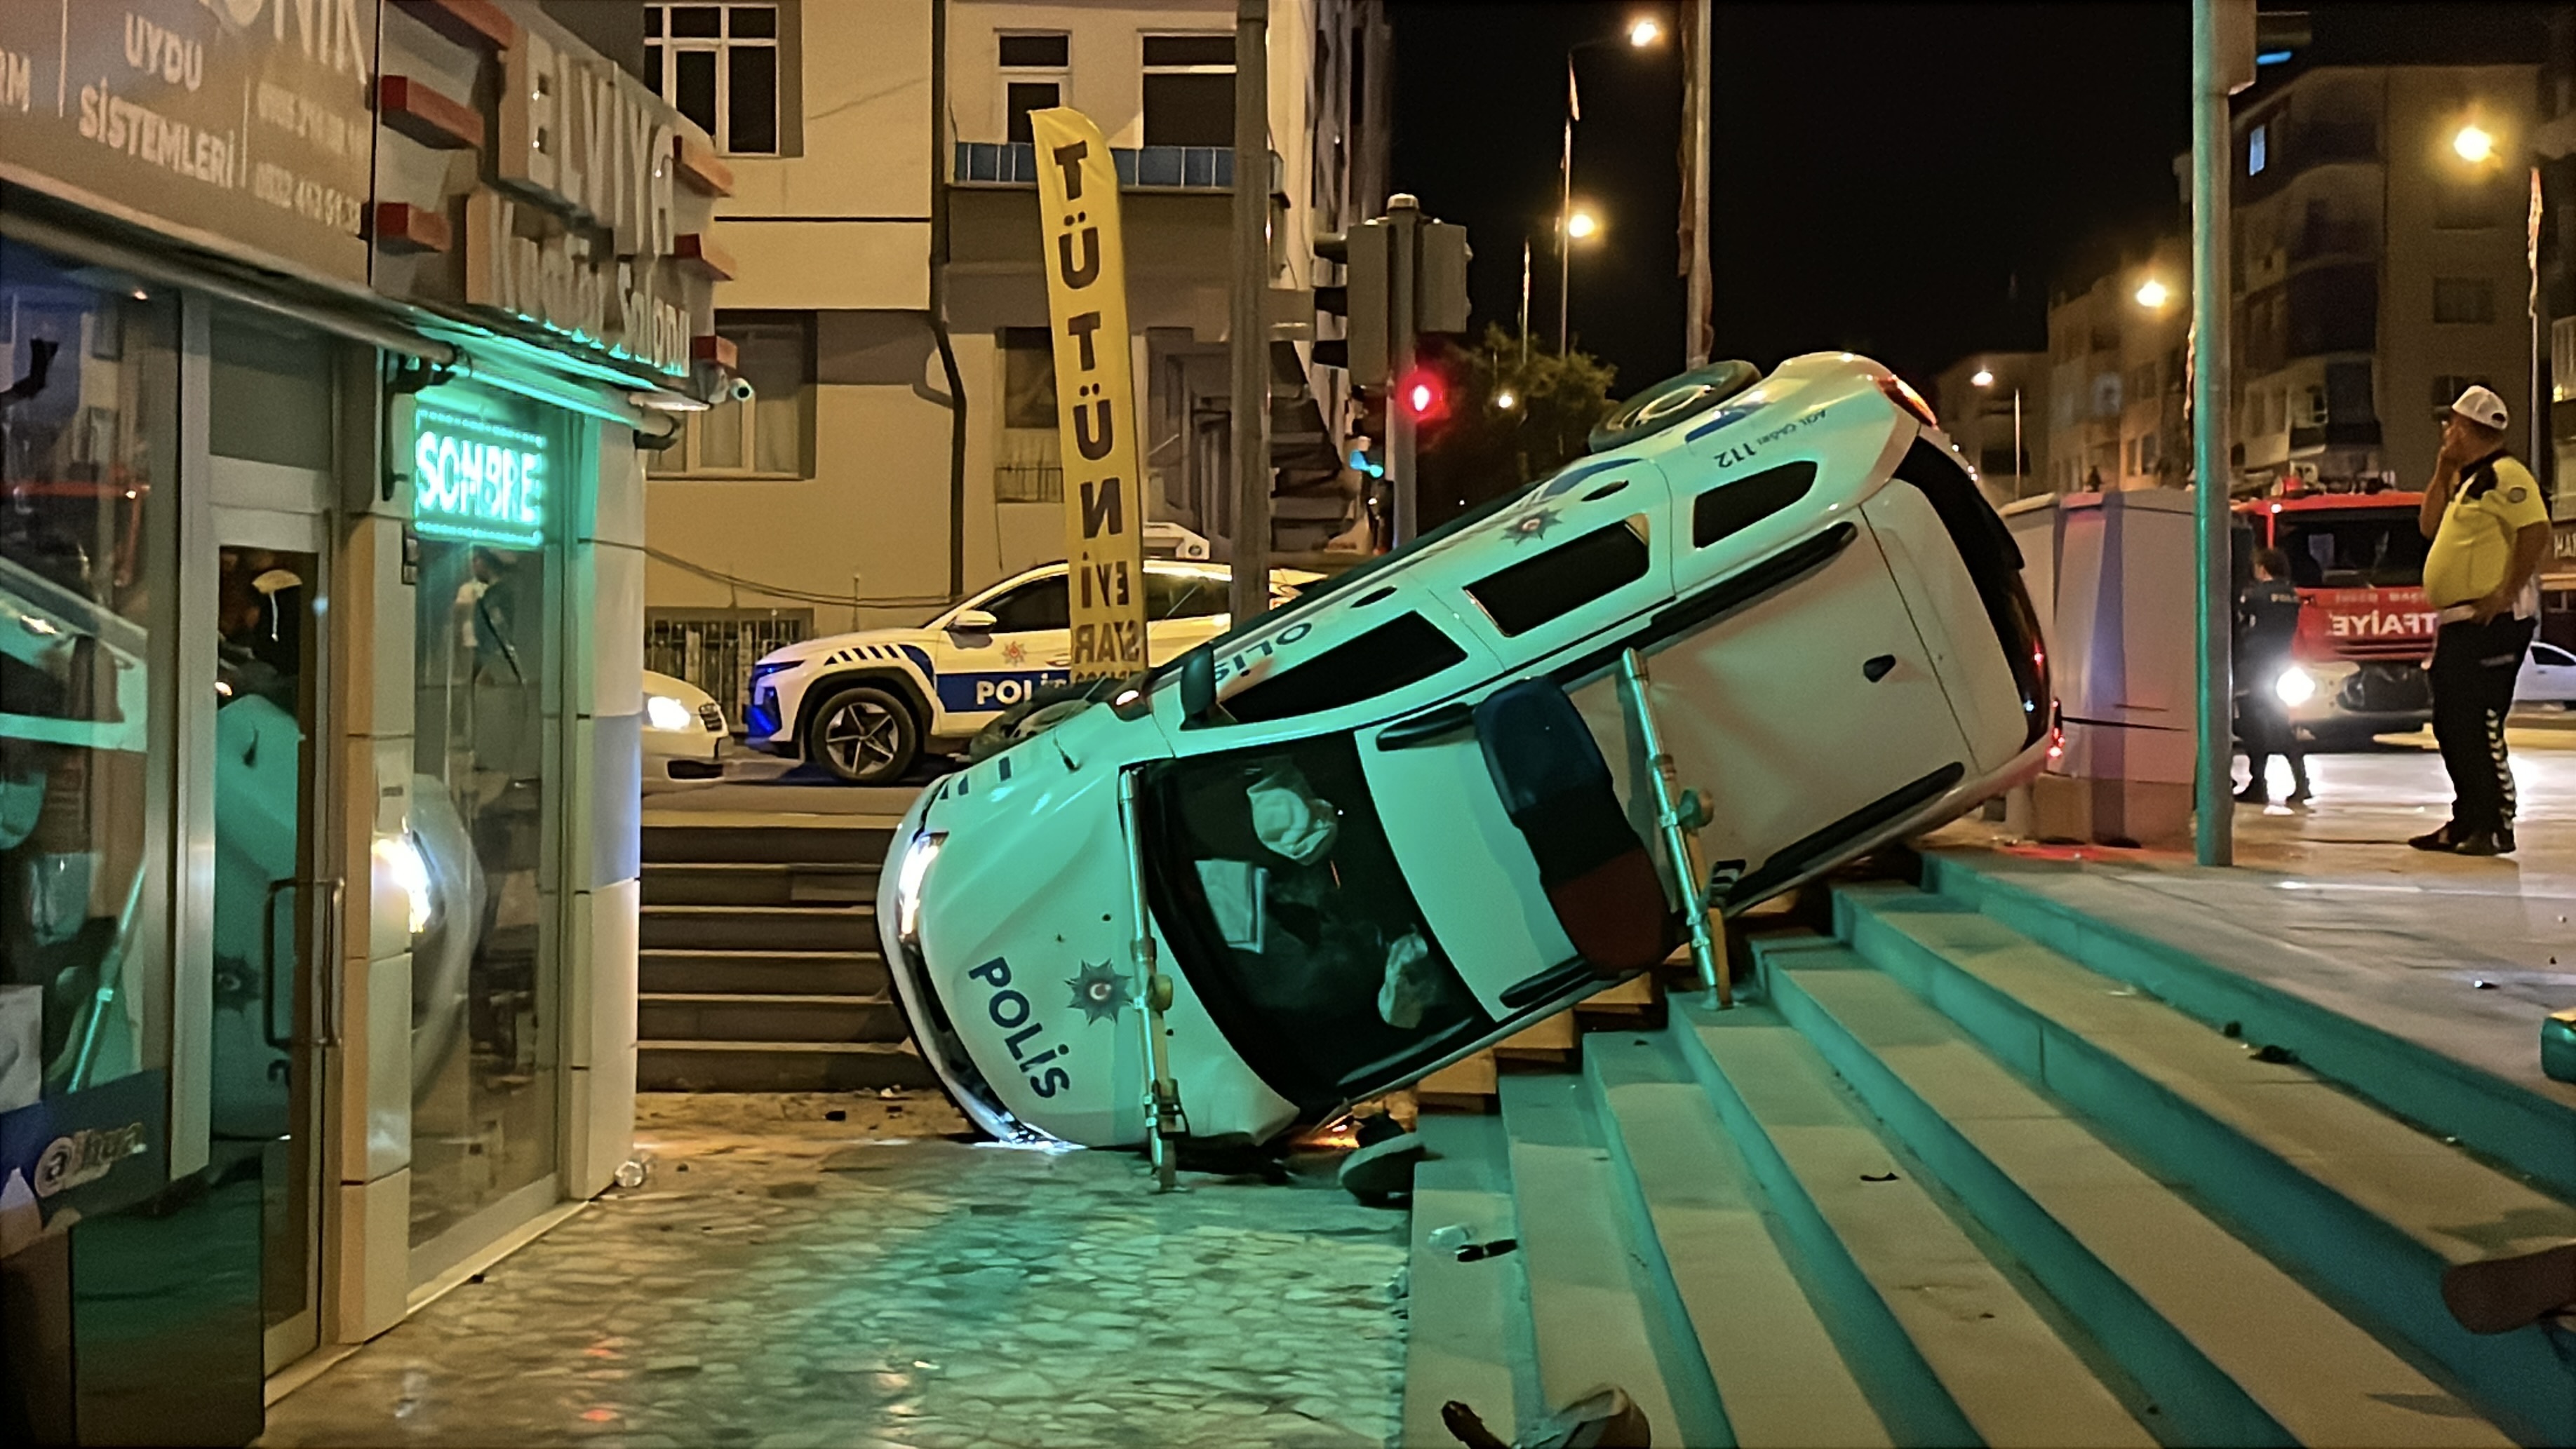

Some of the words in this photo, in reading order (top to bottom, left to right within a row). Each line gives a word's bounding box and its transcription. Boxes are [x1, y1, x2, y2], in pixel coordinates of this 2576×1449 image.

[126, 11, 203, 92] UYDU
[79, 75, 235, 189] SİSTEMLERİ
[1713, 443, 1757, 468] 112
